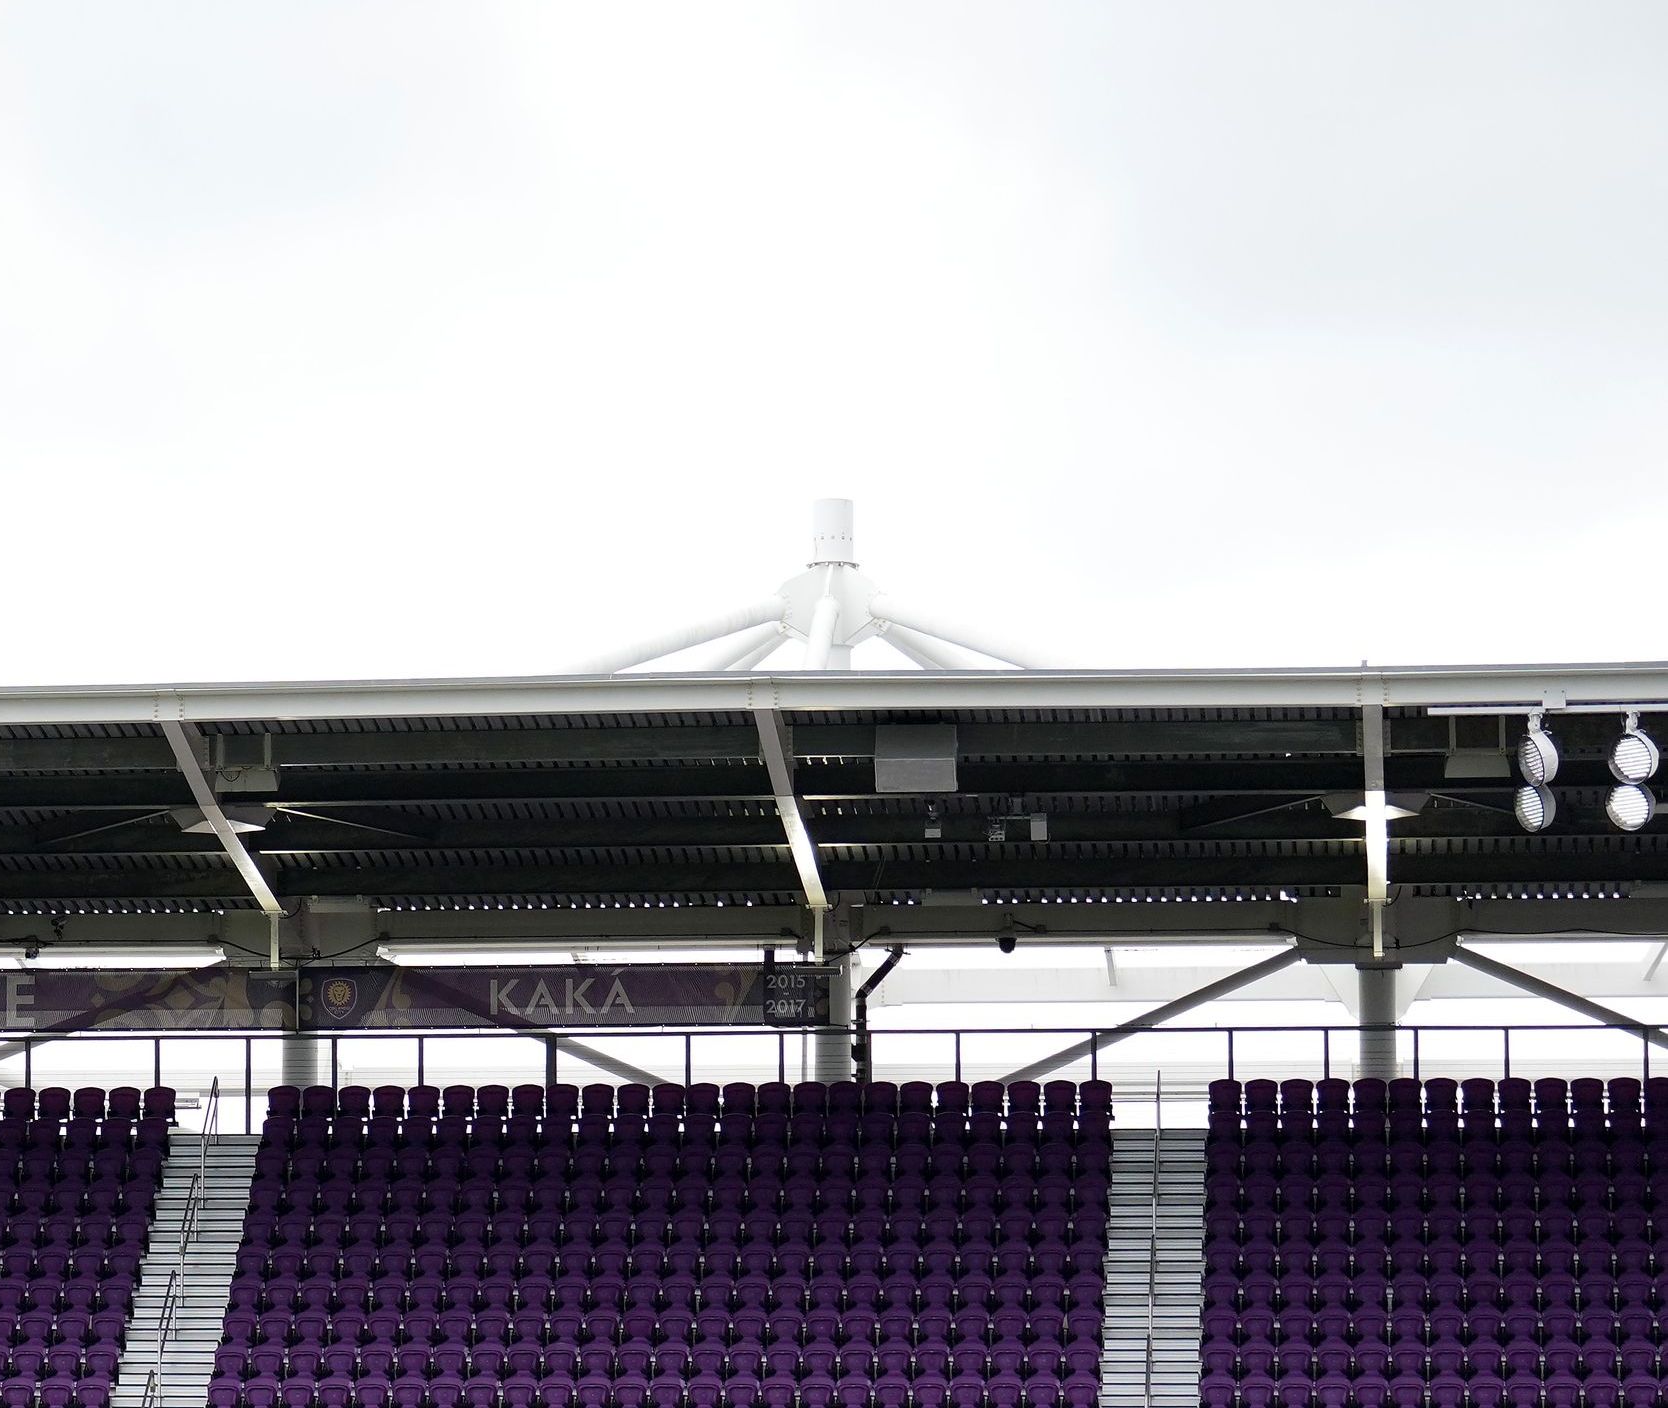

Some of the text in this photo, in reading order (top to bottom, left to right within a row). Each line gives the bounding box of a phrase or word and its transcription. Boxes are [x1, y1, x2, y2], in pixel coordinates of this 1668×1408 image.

[766, 973, 808, 991] 2015
[487, 968, 637, 1017] KAKÁ
[766, 997, 808, 1016] 2017
